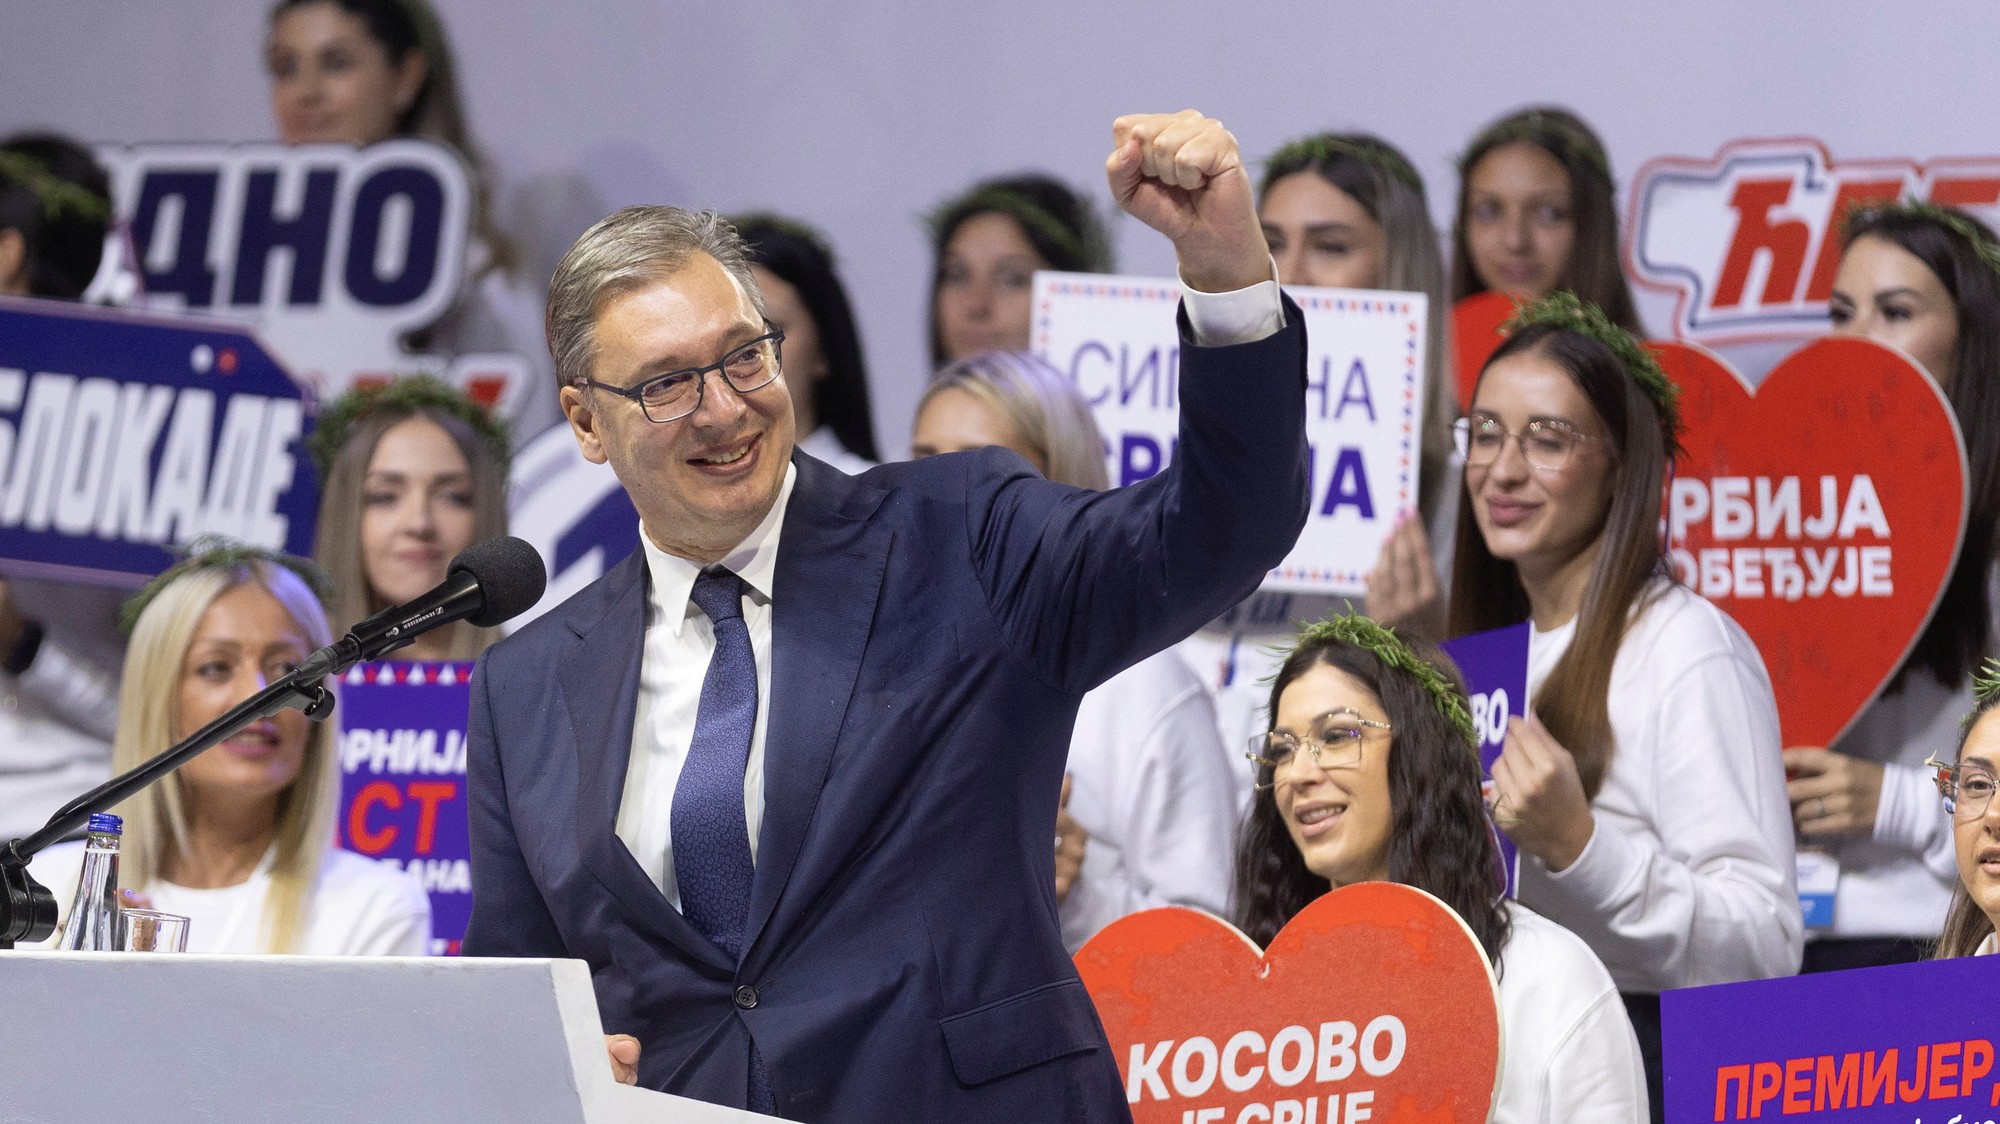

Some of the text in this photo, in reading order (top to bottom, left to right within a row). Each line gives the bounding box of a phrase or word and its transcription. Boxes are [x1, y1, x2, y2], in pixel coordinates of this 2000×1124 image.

[1658, 474, 1891, 541] РБИЈА
[339, 728, 467, 775] РНИЈ
[333, 780, 457, 855] СТ
[1127, 1014, 1407, 1104] КОСОВО
